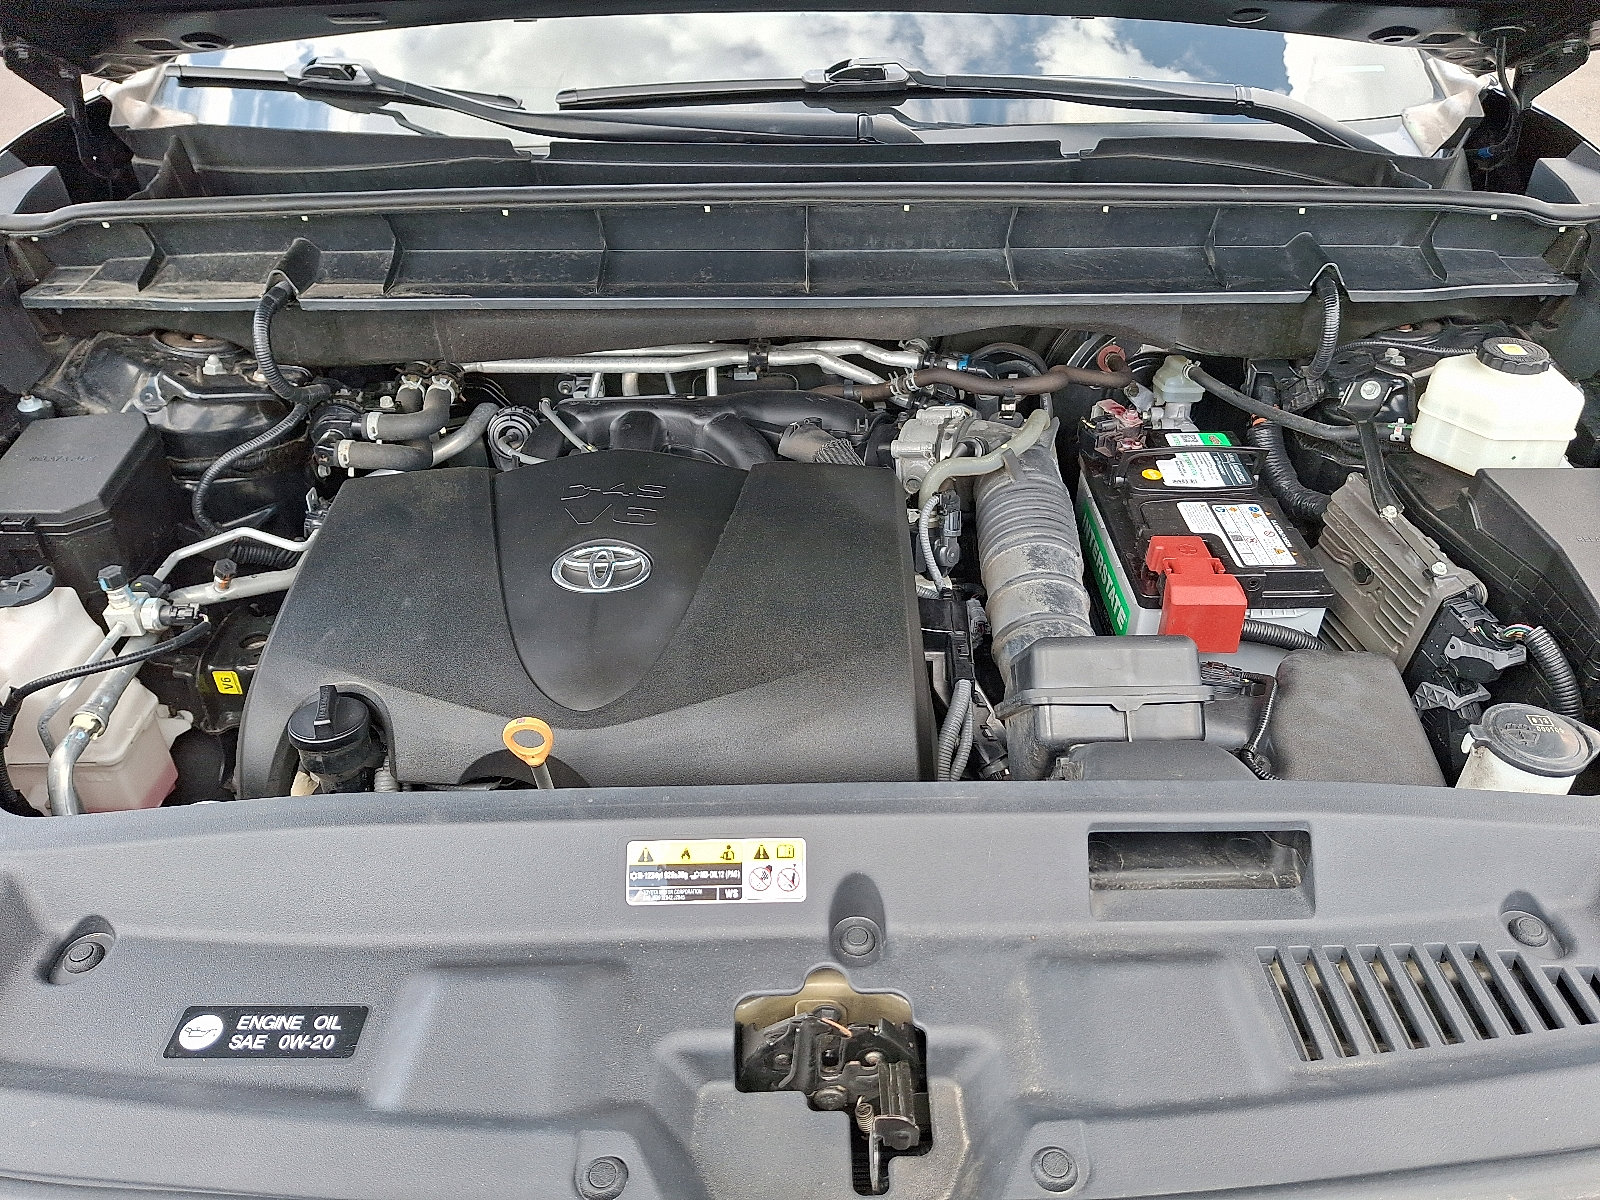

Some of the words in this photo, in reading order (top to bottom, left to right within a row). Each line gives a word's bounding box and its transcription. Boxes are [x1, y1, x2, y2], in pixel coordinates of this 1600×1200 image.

[1081, 512, 1127, 631] INTERSTATE
[220, 676, 234, 690] V6
[236, 1014, 305, 1031] ENGINE
[313, 1014, 342, 1031] OIL
[228, 1034, 269, 1051] SAE
[278, 1034, 336, 1051] 0W-20
